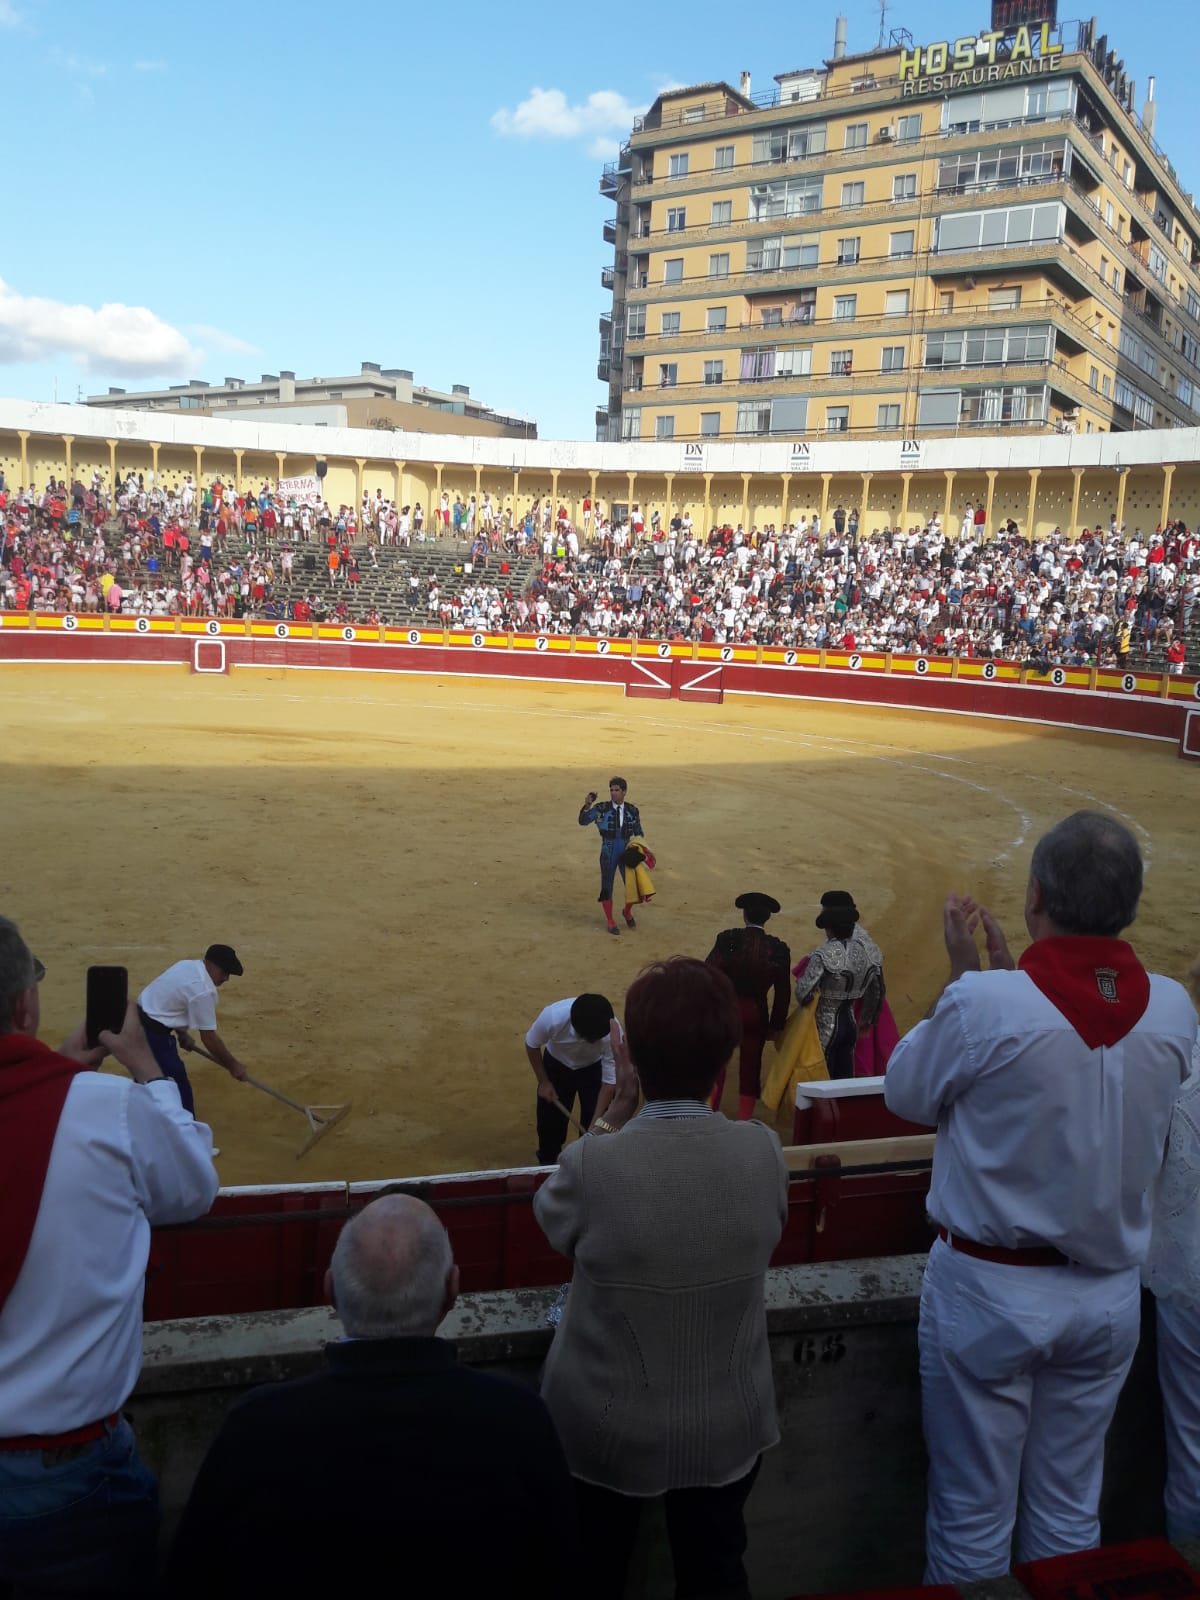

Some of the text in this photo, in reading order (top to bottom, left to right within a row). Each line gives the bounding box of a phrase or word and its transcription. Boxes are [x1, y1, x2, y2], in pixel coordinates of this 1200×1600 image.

[899, 22, 1064, 81] HOSTAL
[903, 54, 1062, 96] RESTAURANTE
[685, 444, 703, 455] DN
[792, 443, 810, 454] DN
[902, 441, 920, 452] DN
[66, 617, 75, 628] 5
[139, 620, 146, 630] 6
[210, 623, 217, 633] 6
[278, 625, 285, 635] 6
[345, 629, 352, 639] 6
[410, 632, 417, 642] 6
[474, 635, 481, 645] 6
[538, 638, 545, 648] 7
[600, 642, 607, 652] 7
[661, 645, 668, 655] 7
[723, 649, 731, 659] 7
[787, 652, 795, 662] 7
[851, 656, 859, 667] 7
[918, 660, 926, 672] 8
[985, 664, 993, 677] 8
[1054, 670, 1062, 683] 8
[1125, 676, 1133, 690] 8
